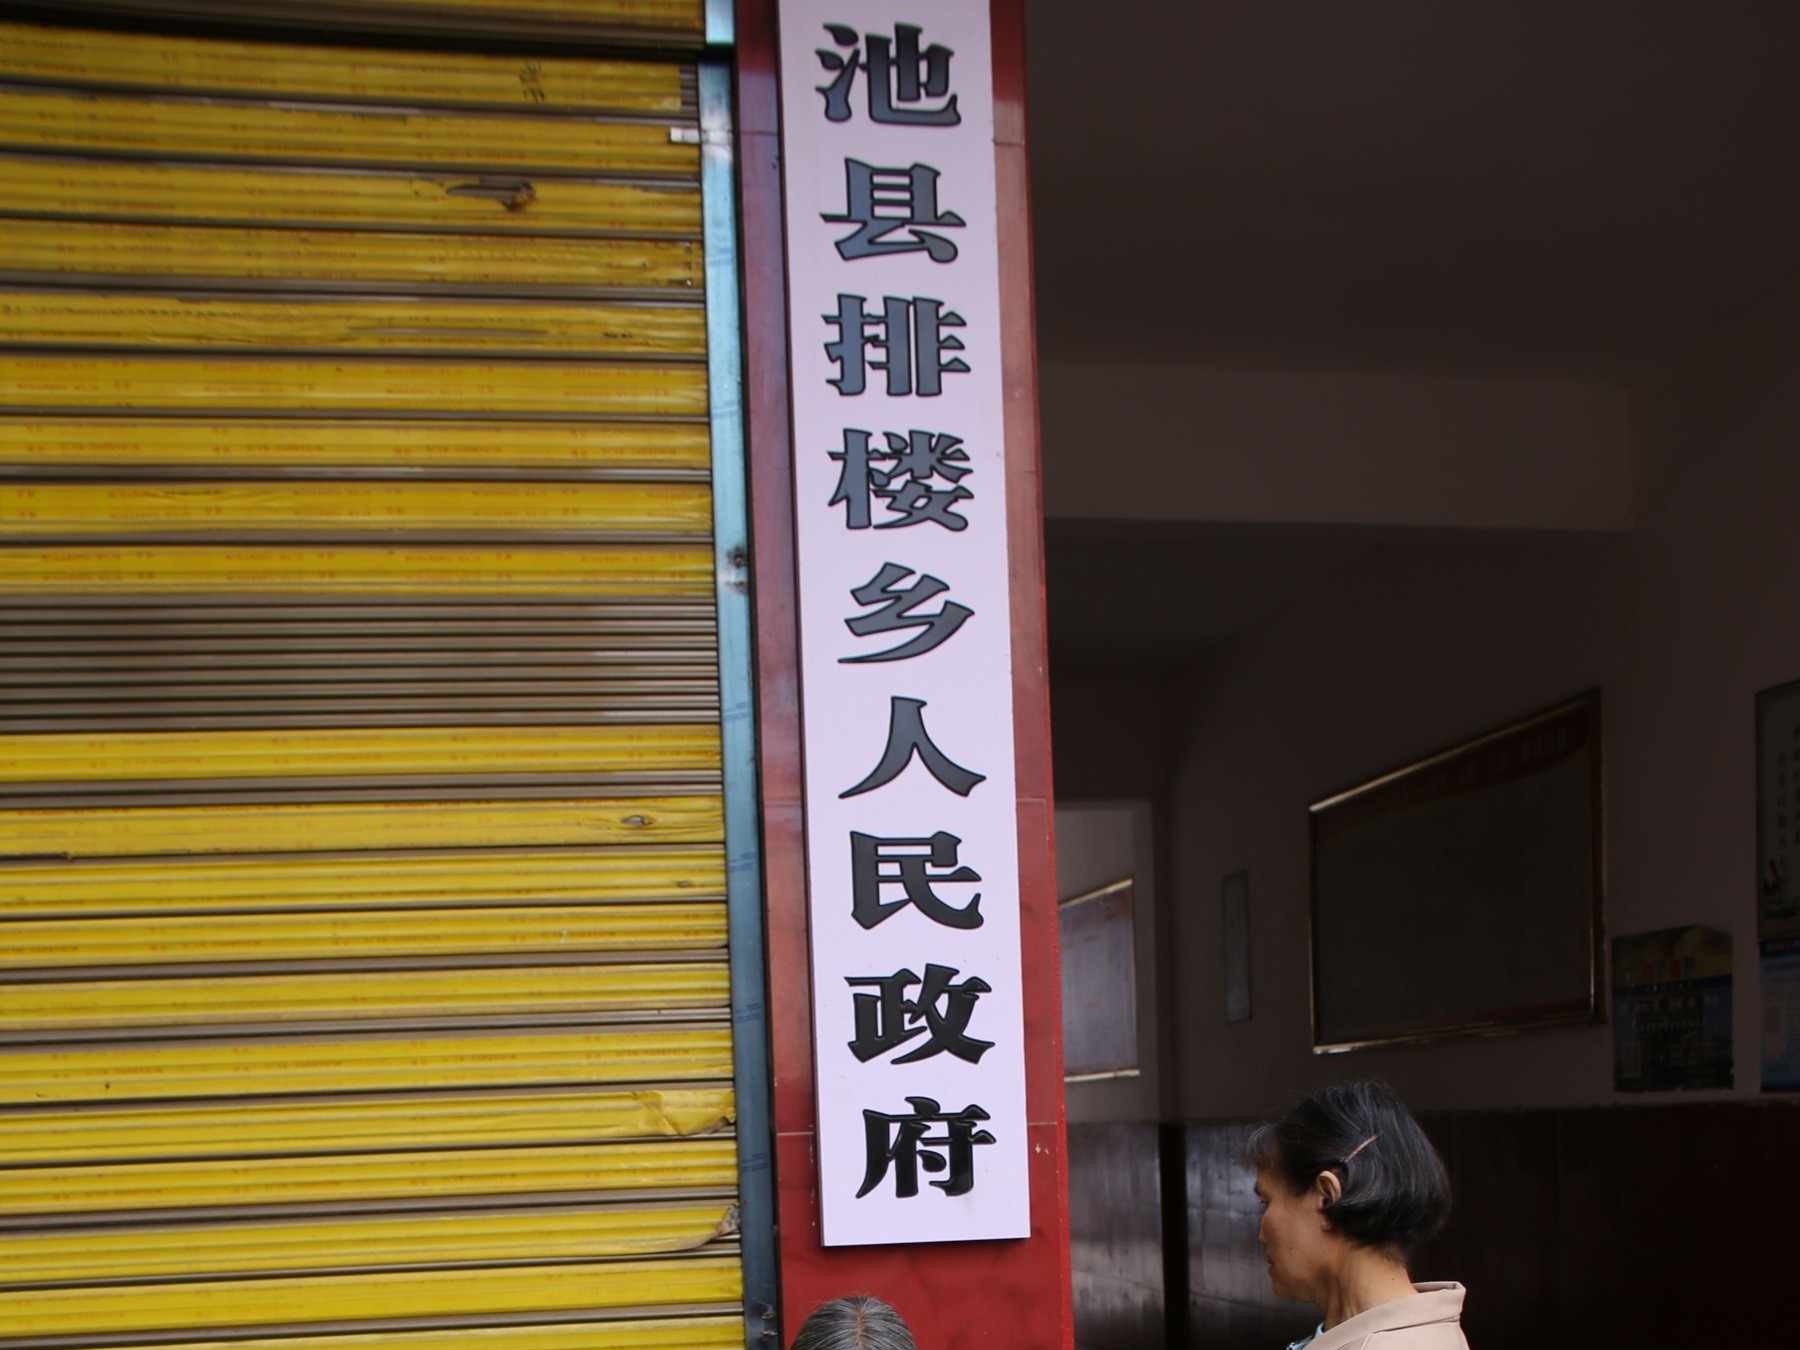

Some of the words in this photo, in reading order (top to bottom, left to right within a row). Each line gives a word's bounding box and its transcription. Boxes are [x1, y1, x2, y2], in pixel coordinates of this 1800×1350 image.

[815, 22, 997, 1199] 池县排楼乡人民政府
